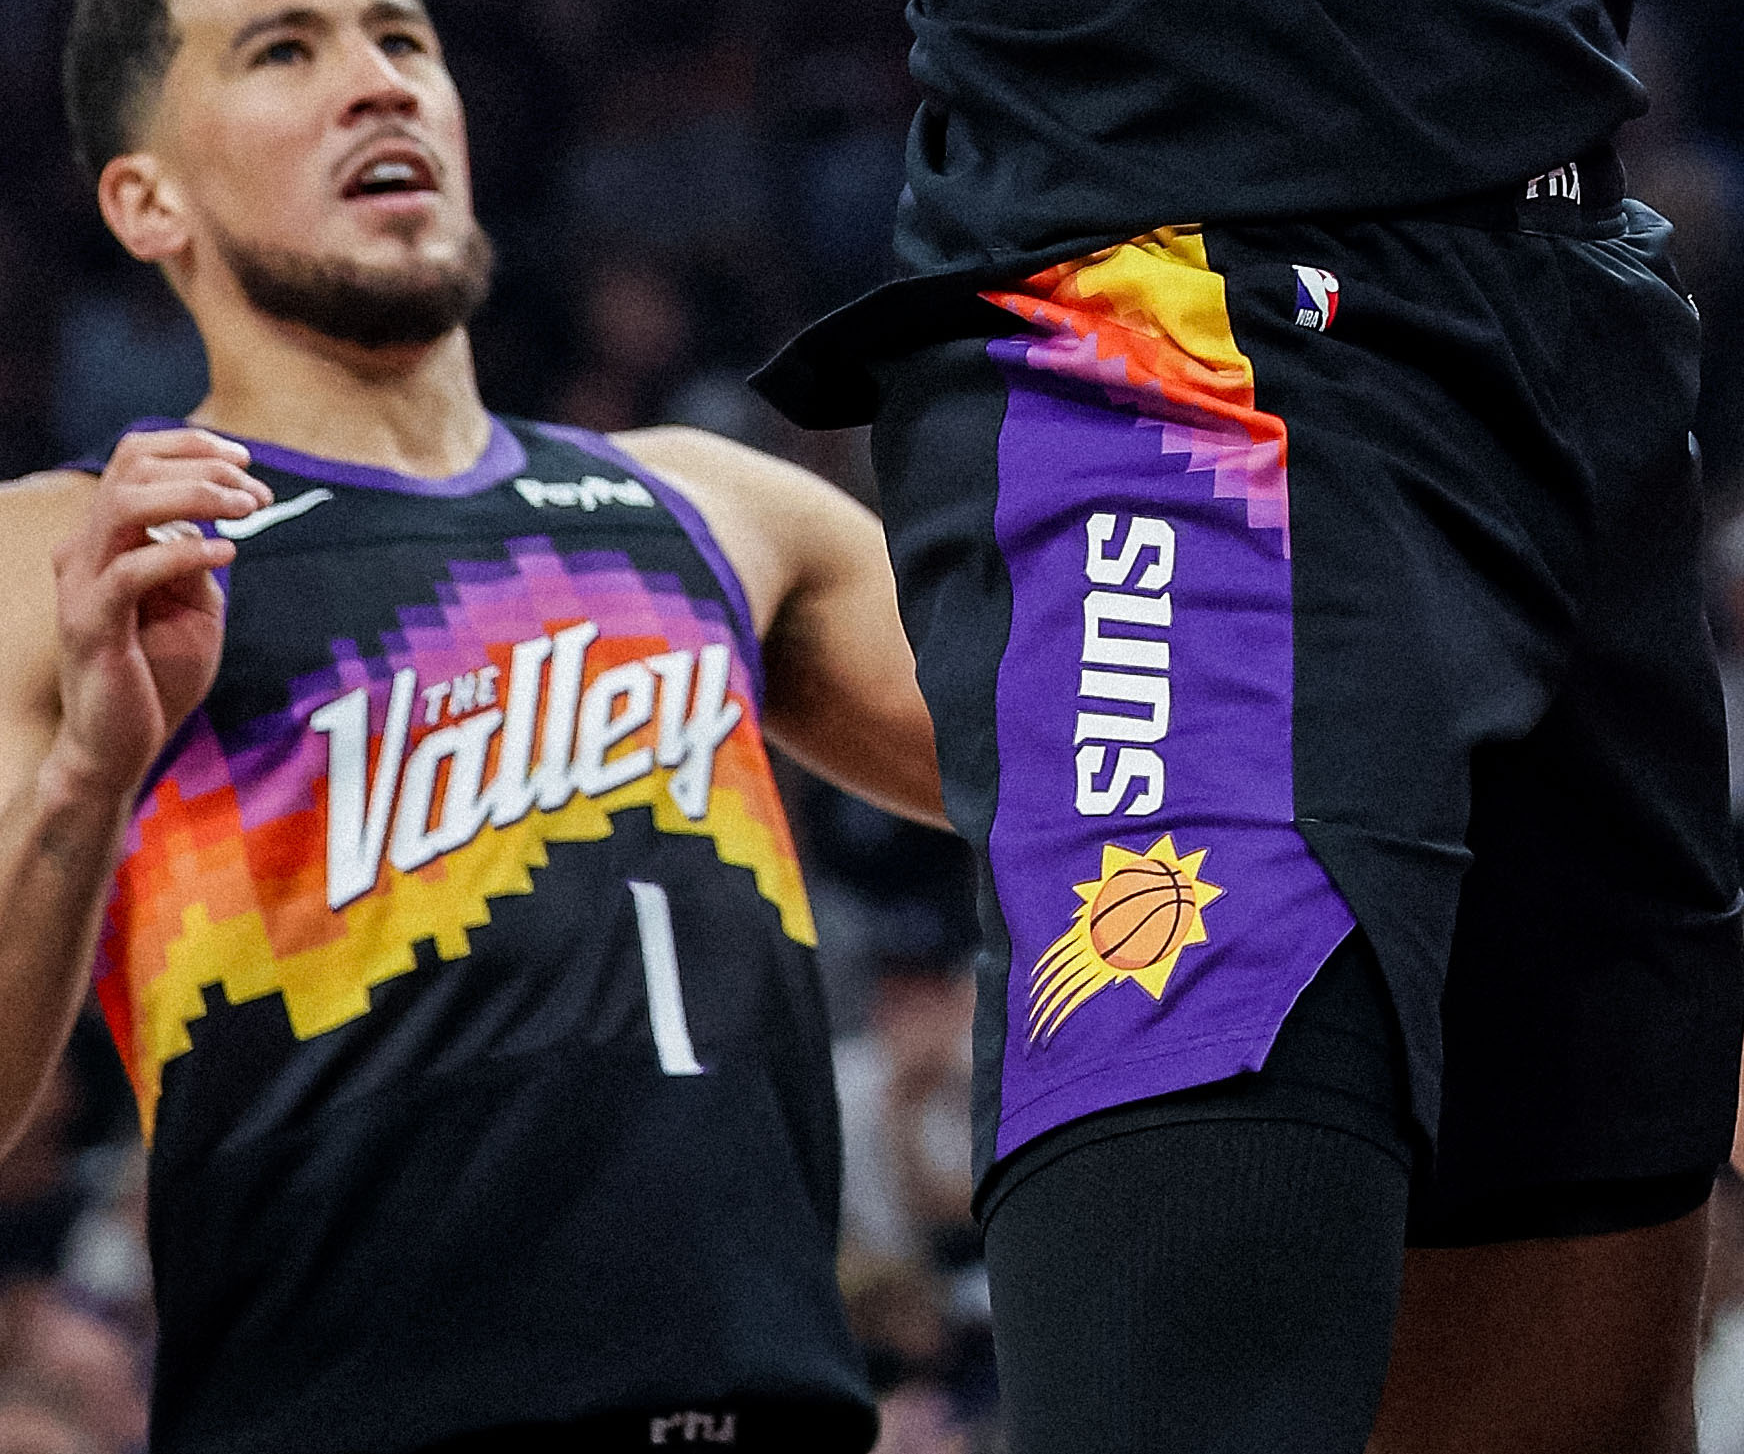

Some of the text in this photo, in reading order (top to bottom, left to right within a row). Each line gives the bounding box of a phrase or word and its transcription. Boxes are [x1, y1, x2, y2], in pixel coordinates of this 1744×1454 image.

[1295, 308, 1320, 329] NBA
[309, 621, 742, 911] THE Valley
[629, 880, 704, 1077] 1
